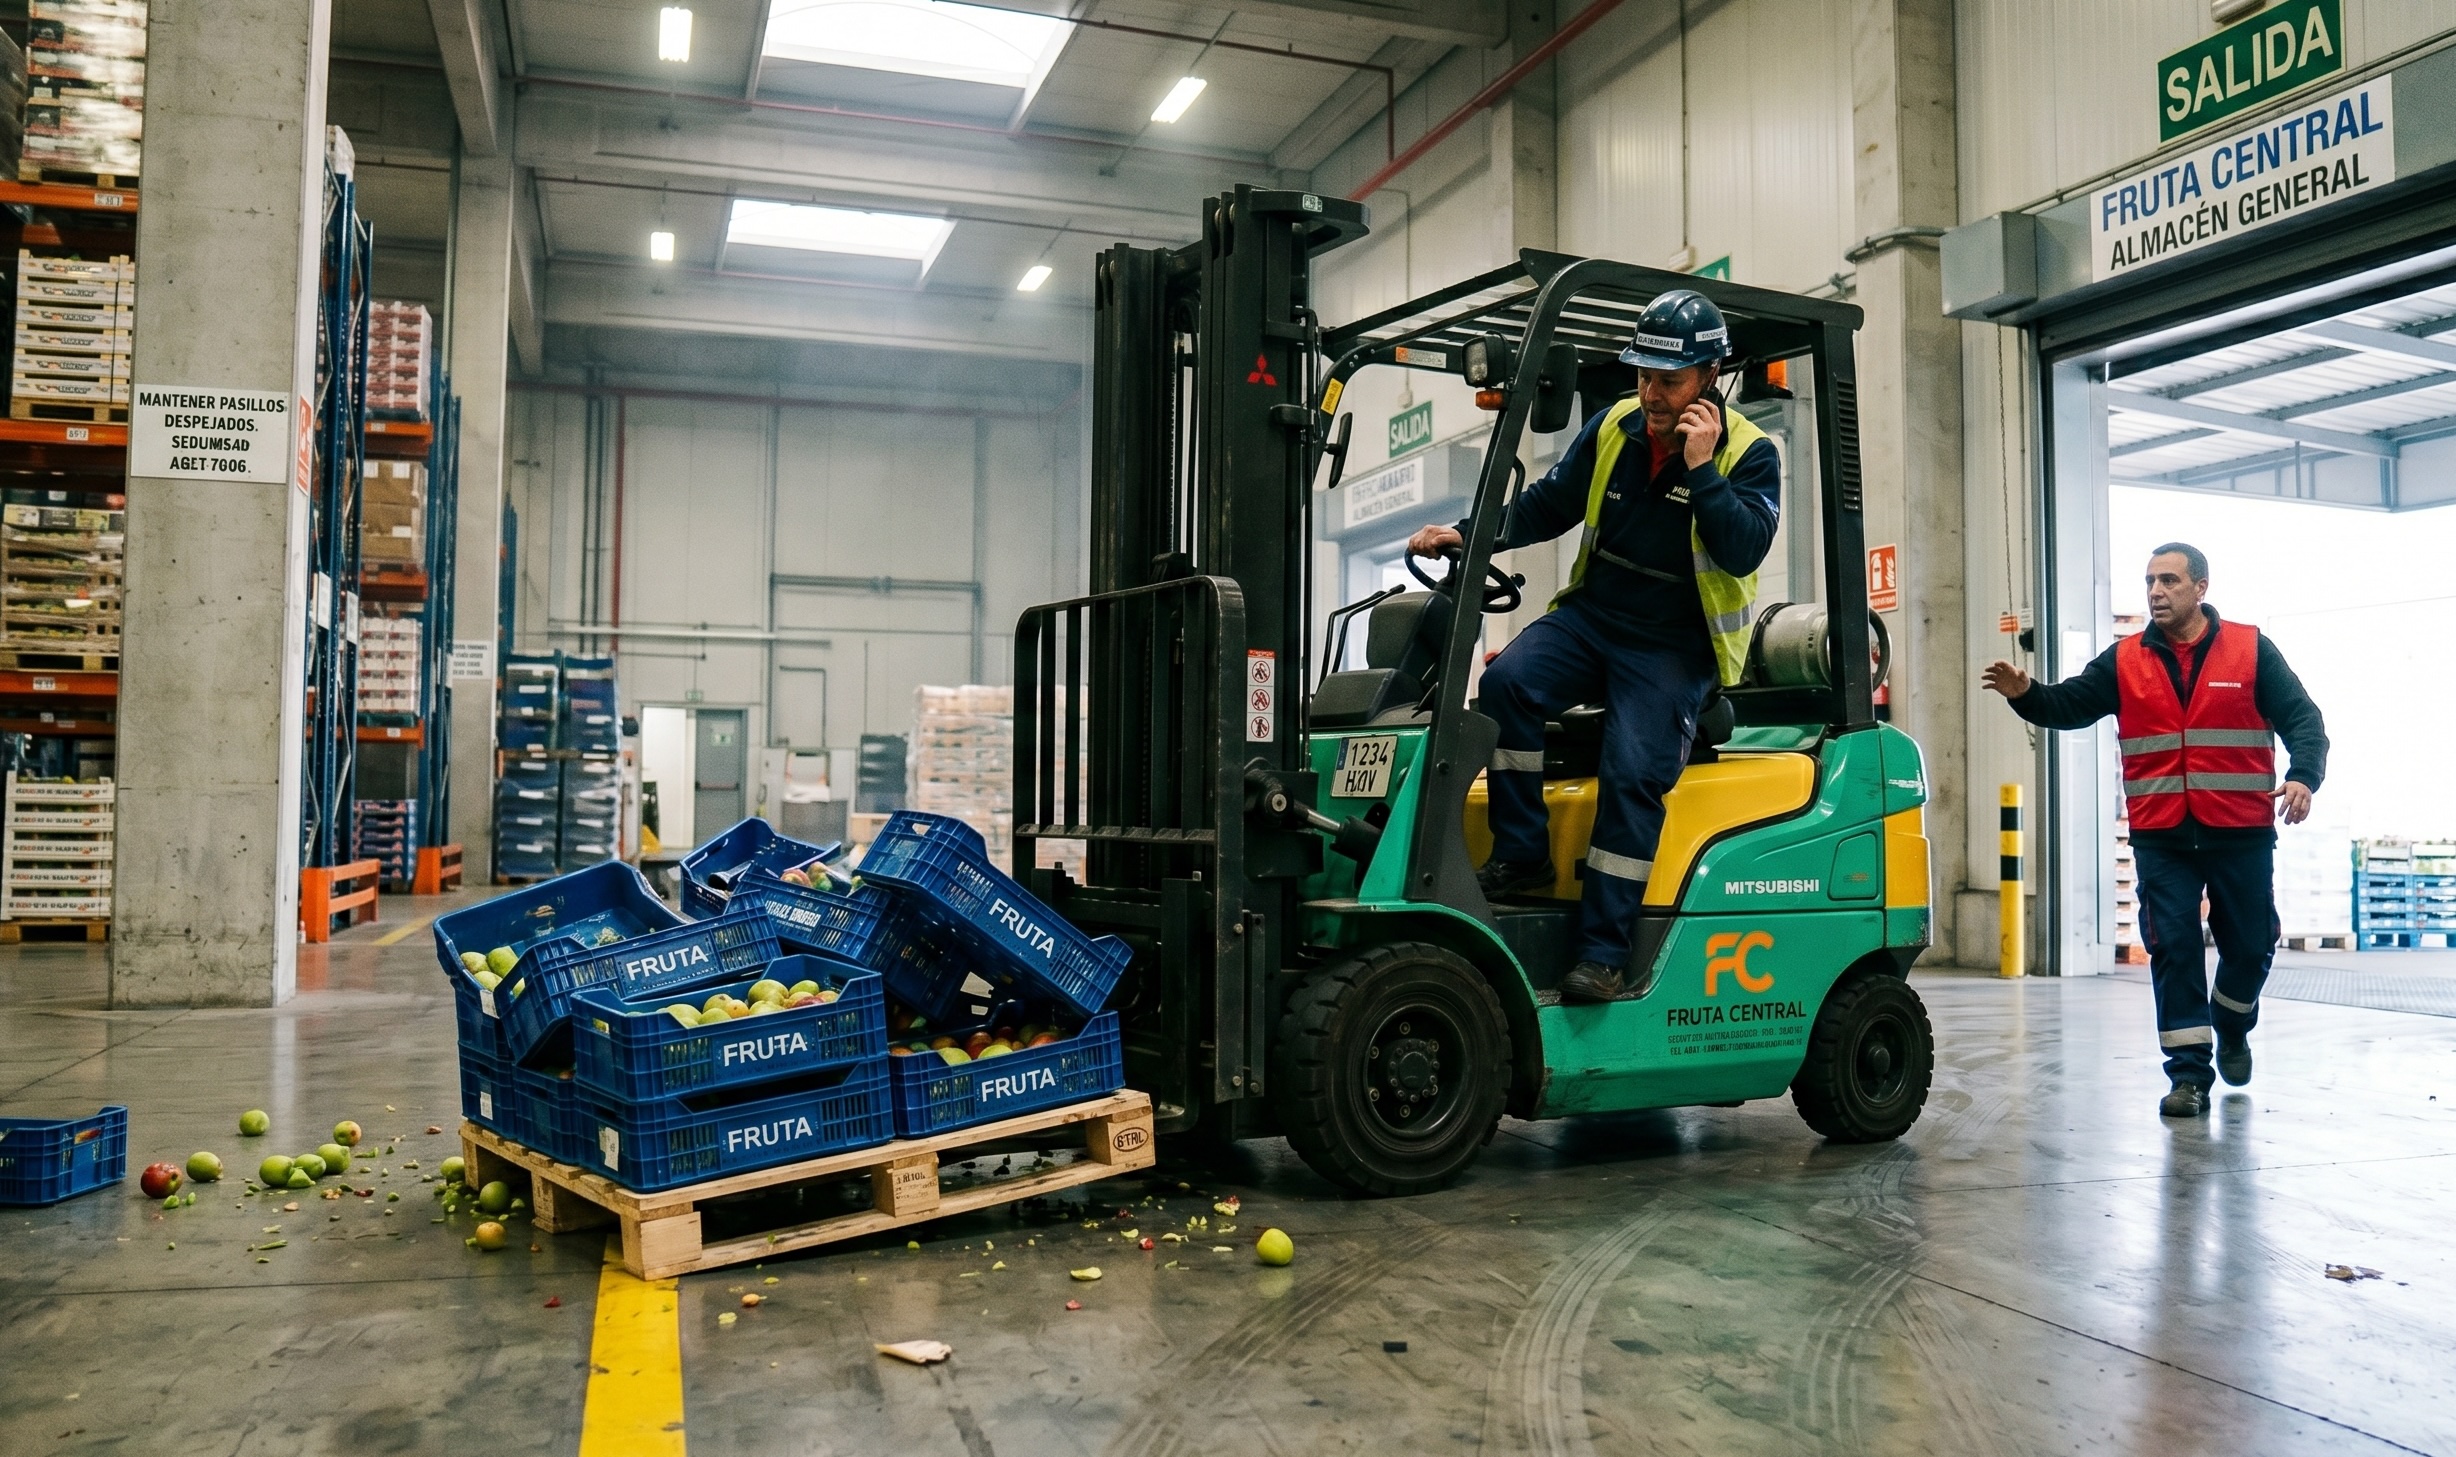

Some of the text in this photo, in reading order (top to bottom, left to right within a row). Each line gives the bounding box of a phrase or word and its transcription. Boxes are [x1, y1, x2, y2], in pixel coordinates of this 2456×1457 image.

[2166, 5, 2334, 122] SALIDA
[2102, 91, 2383, 232] FRUTA CENTRAL
[2110, 153, 2370, 271] ALMACÉN GENERAL
[139, 392, 285, 413] MANTENER PASILLOS
[164, 414, 259, 432] DESPEJADOS.
[1390, 410, 1430, 451] SALIDA
[1352, 741, 1389, 767] 1234
[1725, 879, 1820, 895] MITSUBISHI
[988, 897, 1055, 959] FRUTA
[625, 945, 709, 981] FRUTA
[1705, 930, 1775, 997] FC
[1667, 1001, 1807, 1027] FRUTA CENTRAL
[723, 1032, 808, 1067] FRUTA
[981, 1067, 1056, 1103] FRUTA
[727, 1116, 813, 1153] FRUTA
